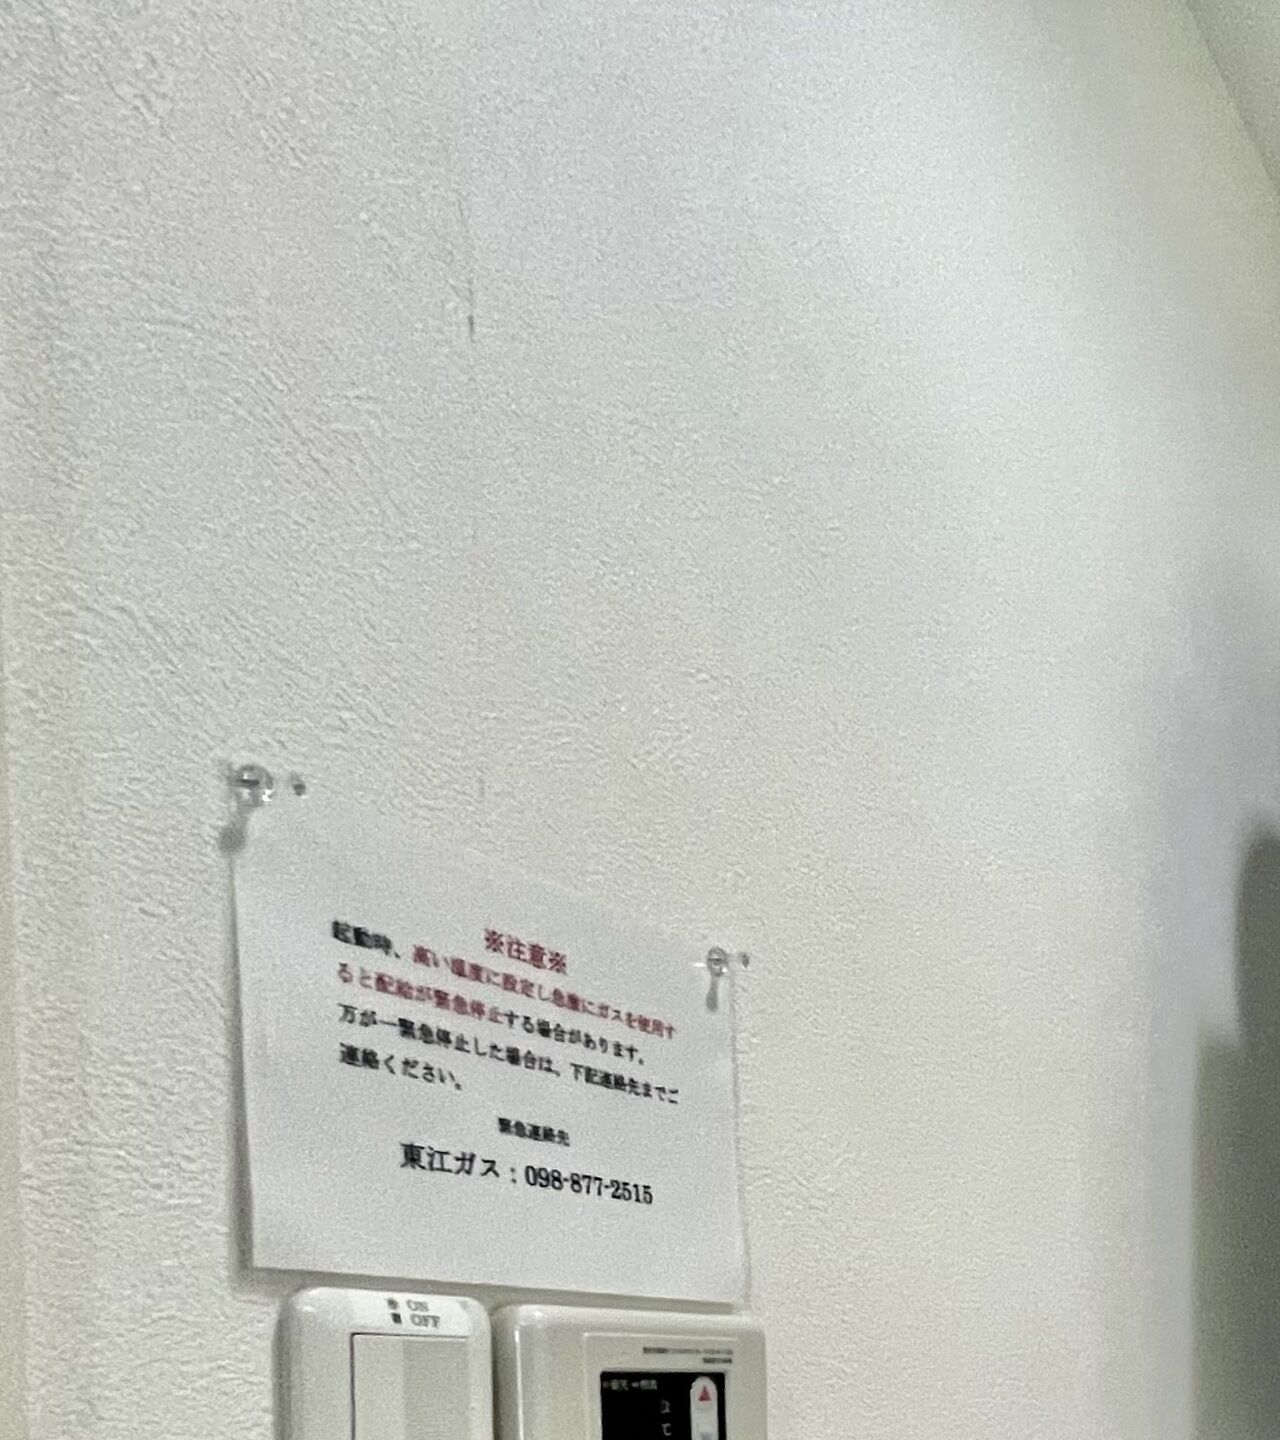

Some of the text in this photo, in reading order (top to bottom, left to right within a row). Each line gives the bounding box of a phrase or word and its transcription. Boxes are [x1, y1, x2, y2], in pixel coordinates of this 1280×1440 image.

[484, 928, 567, 975] ※注意※
[339, 1042, 462, 1090] 連絡ください。
[498, 1117, 571, 1147] 緊急連絡先
[406, 1299, 429, 1312] ON
[410, 1313, 441, 1327] OFF
